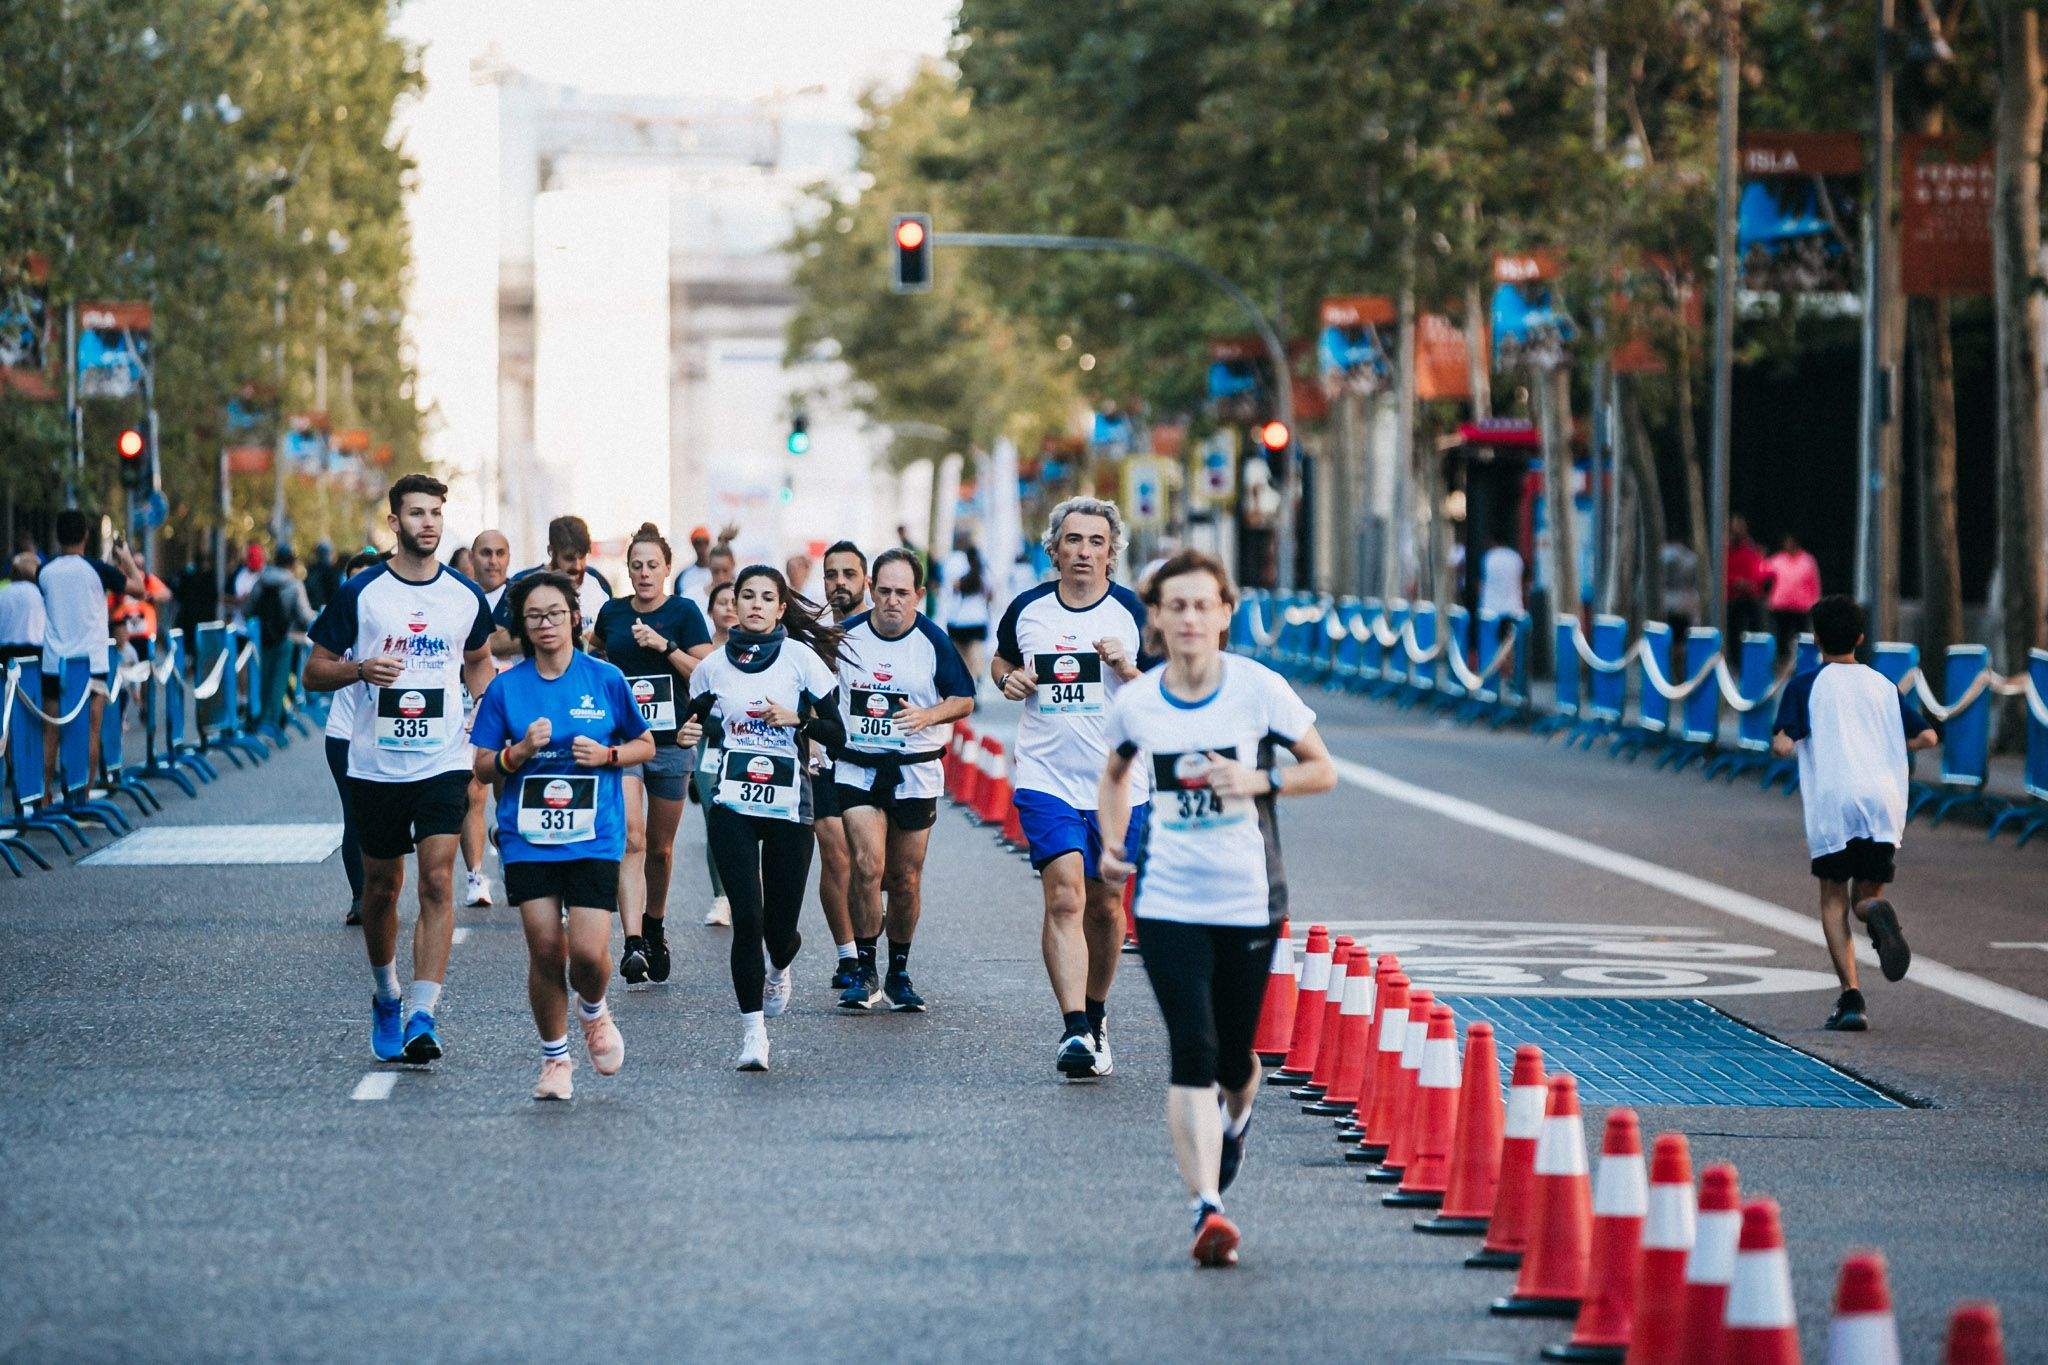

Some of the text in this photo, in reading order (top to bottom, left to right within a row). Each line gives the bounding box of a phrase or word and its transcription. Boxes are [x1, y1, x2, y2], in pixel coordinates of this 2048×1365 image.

[1746, 150, 1799, 172] ISLA
[1051, 684, 1085, 704] 344
[637, 703, 659, 720] 07
[393, 718, 429, 738] 335
[860, 717, 892, 737] 305
[740, 782, 776, 804] 320
[1177, 789, 1223, 819] 324
[541, 809, 575, 830] 331
[1401, 963, 1708, 987] 30
